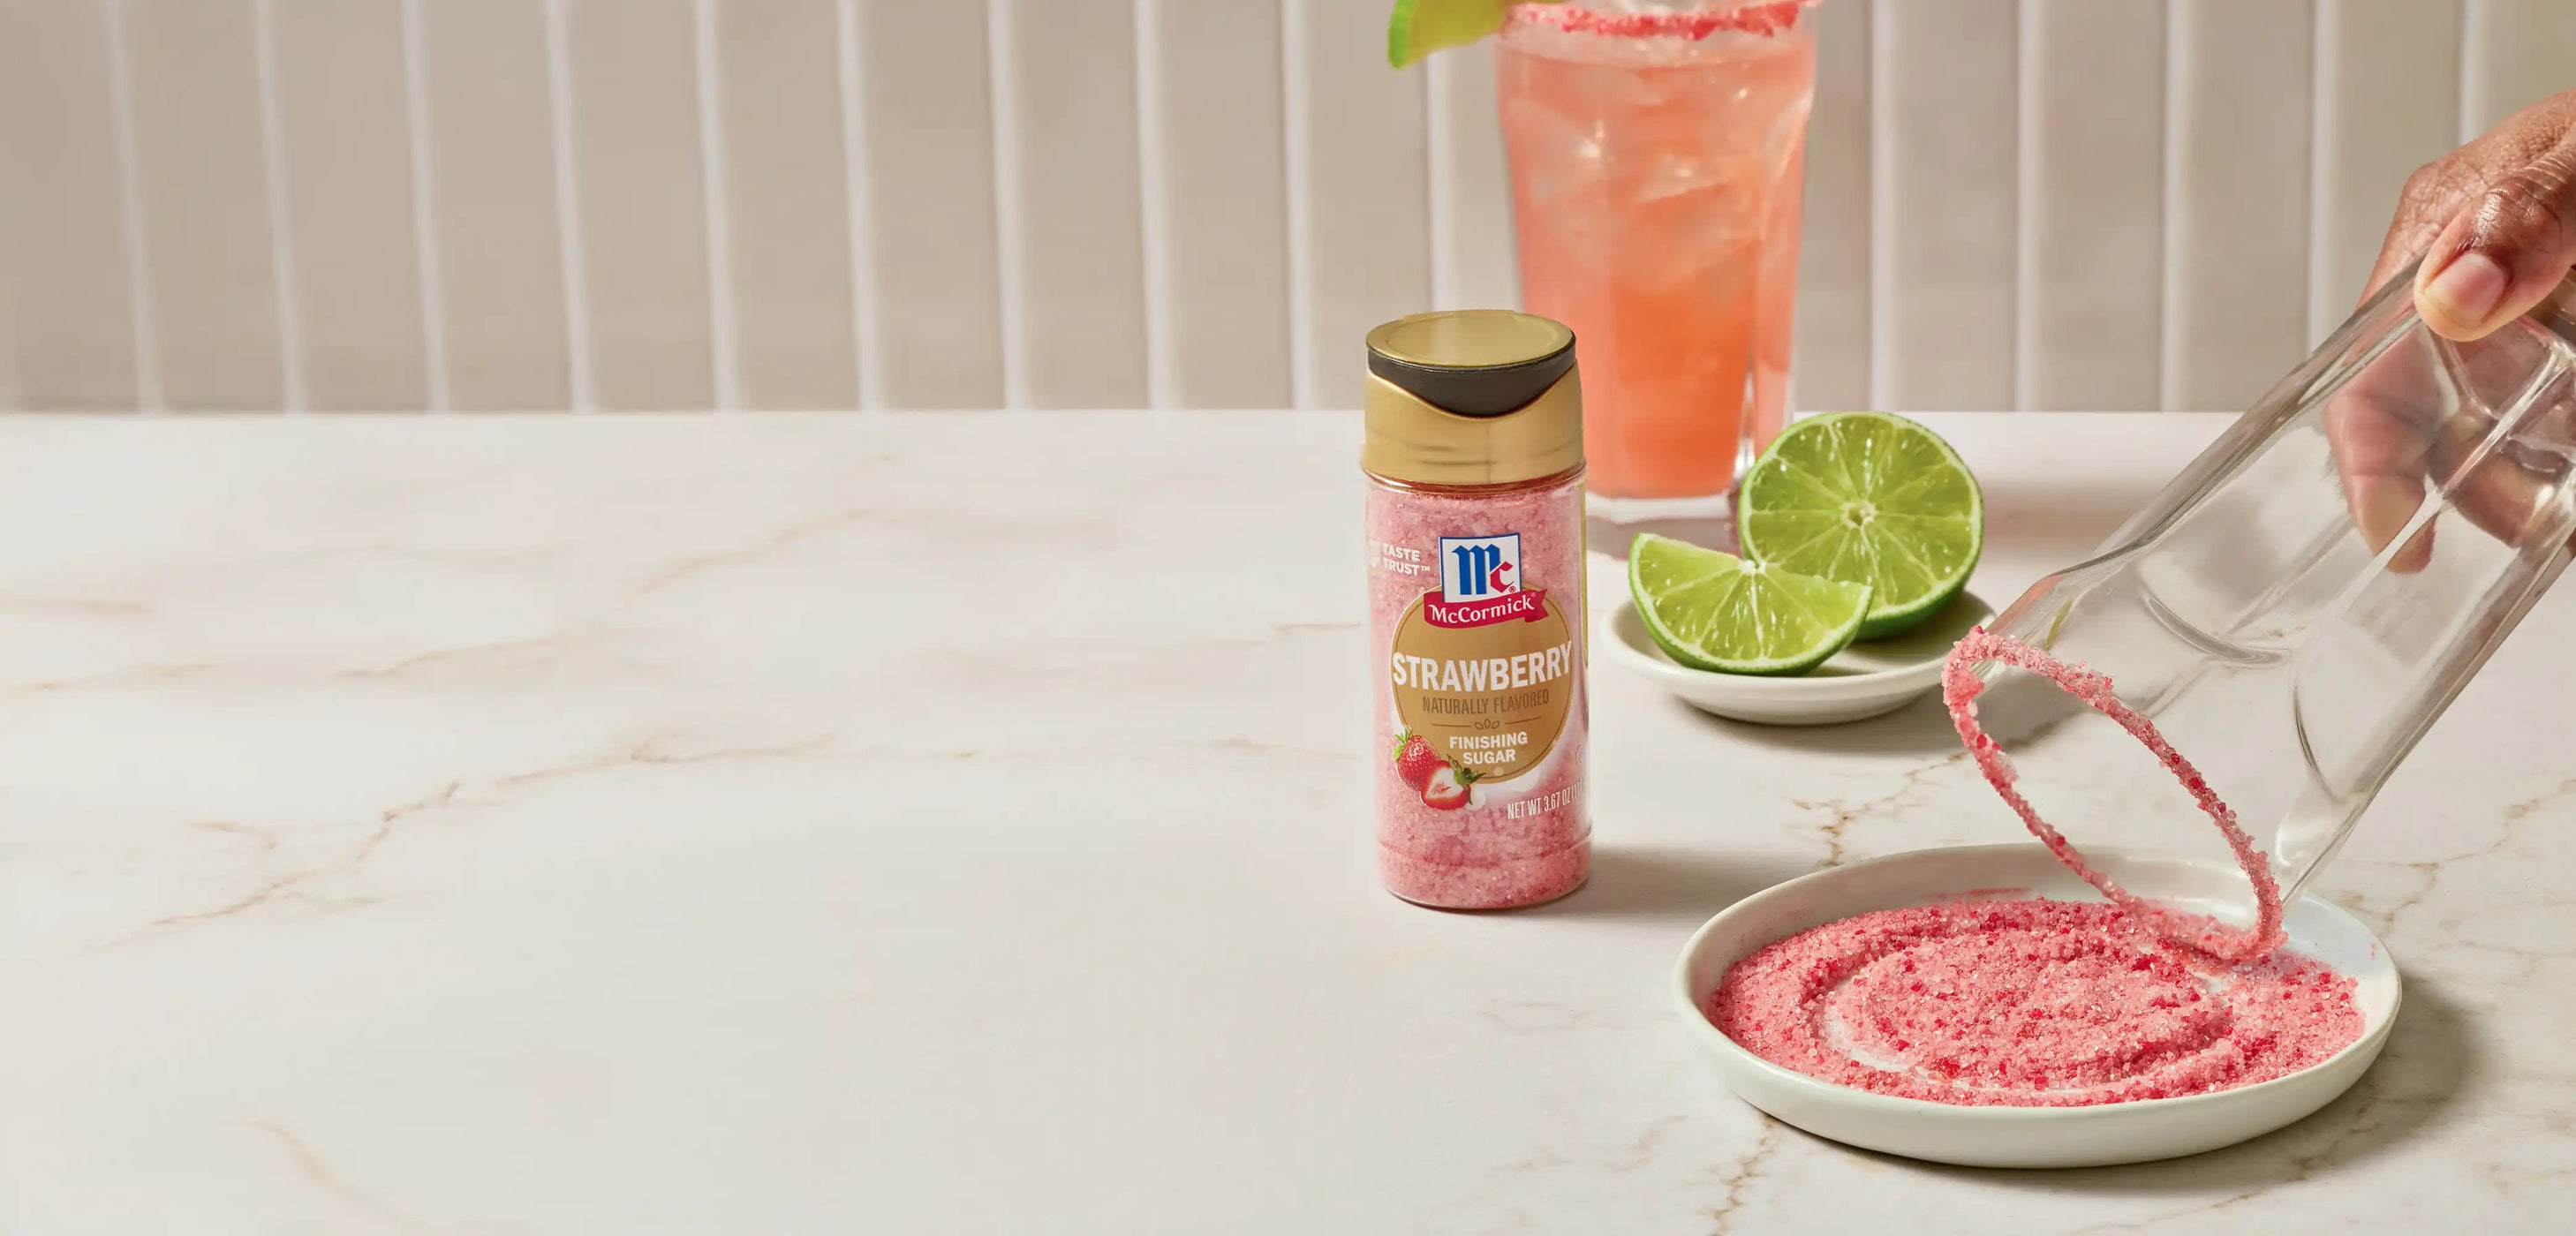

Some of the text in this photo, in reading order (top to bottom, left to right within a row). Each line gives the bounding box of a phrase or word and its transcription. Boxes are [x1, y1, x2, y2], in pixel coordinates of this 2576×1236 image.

[1382, 542, 1420, 562] TASTE
[1393, 640, 1573, 692] STRAWBERRY
[1423, 689, 1549, 714] NATURALLY FLAVORED
[1449, 731, 1528, 750] FINISHING
[1462, 749, 1516, 765] SUGAR
[1507, 801, 1525, 820] NET
[1528, 797, 1542, 816] WT
[1544, 791, 1560, 812] 3.67
[1561, 787, 1571, 806] OZ
